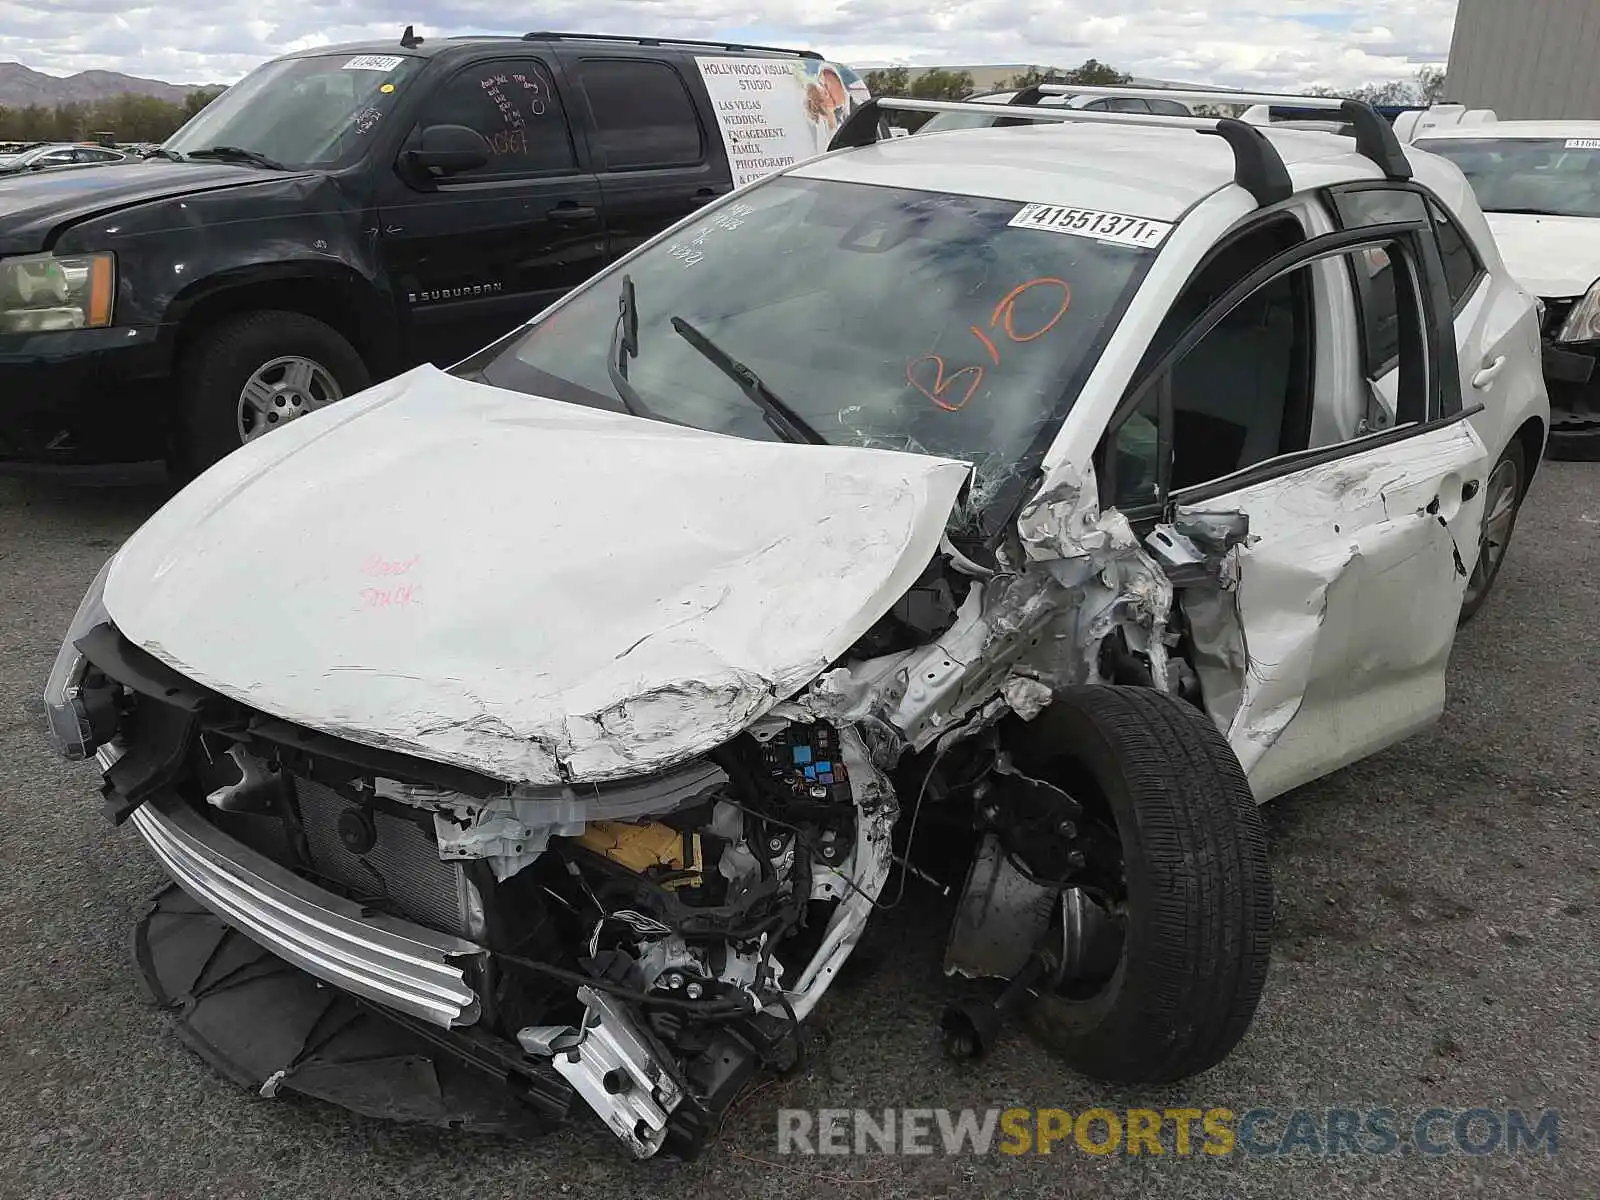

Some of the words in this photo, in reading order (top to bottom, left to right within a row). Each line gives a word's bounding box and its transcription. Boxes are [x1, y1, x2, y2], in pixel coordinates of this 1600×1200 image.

[703, 63, 761, 76] HOLLYWOOD
[762, 64, 794, 76] VISUAL
[739, 80, 772, 91] STUDIO
[719, 101, 735, 111] LAS
[735, 100, 762, 111] VEGAS
[420, 282, 503, 301] SUBURBAN
